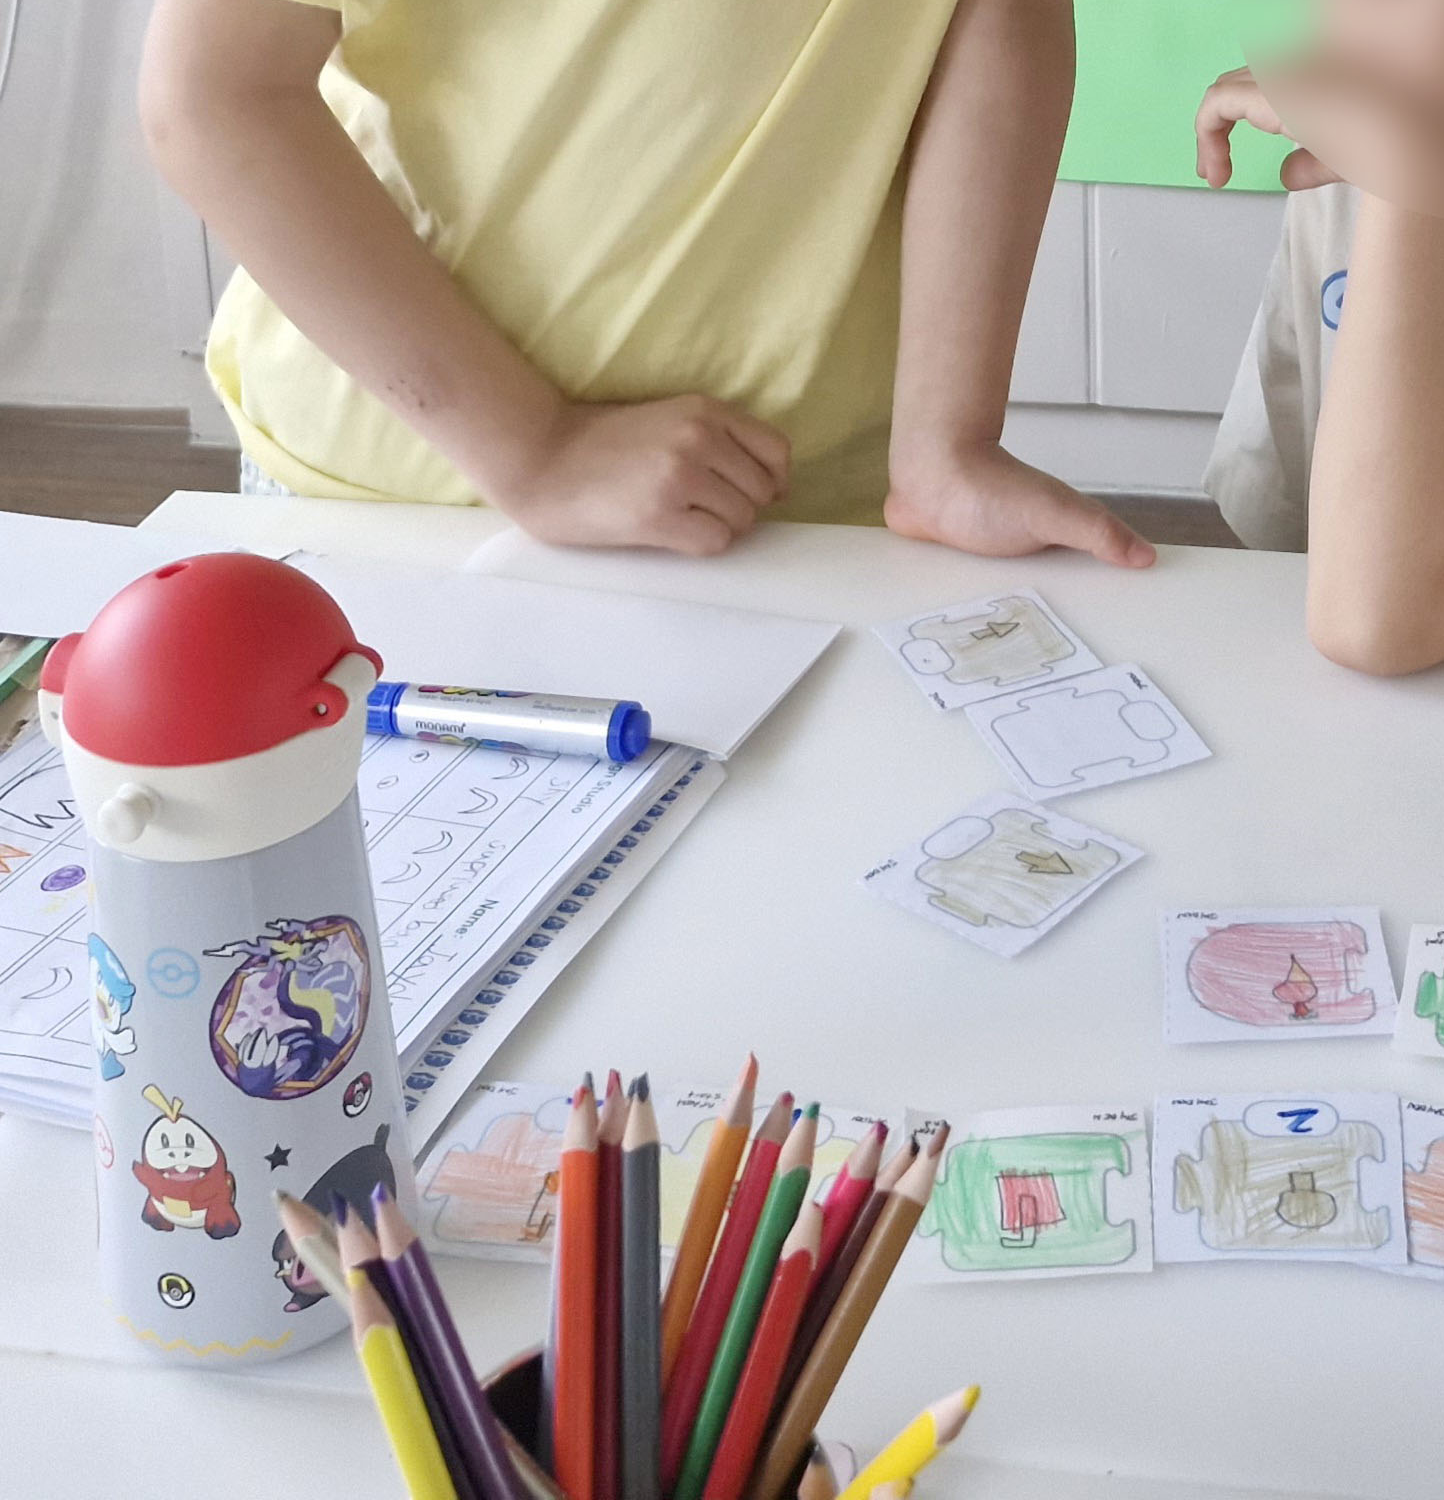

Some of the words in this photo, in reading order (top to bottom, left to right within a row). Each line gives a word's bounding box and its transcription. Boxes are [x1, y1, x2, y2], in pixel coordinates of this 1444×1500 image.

[571, 778, 612, 815] Studio
[453, 899, 499, 939] Name:
[1276, 1108, 1319, 1133] 2
